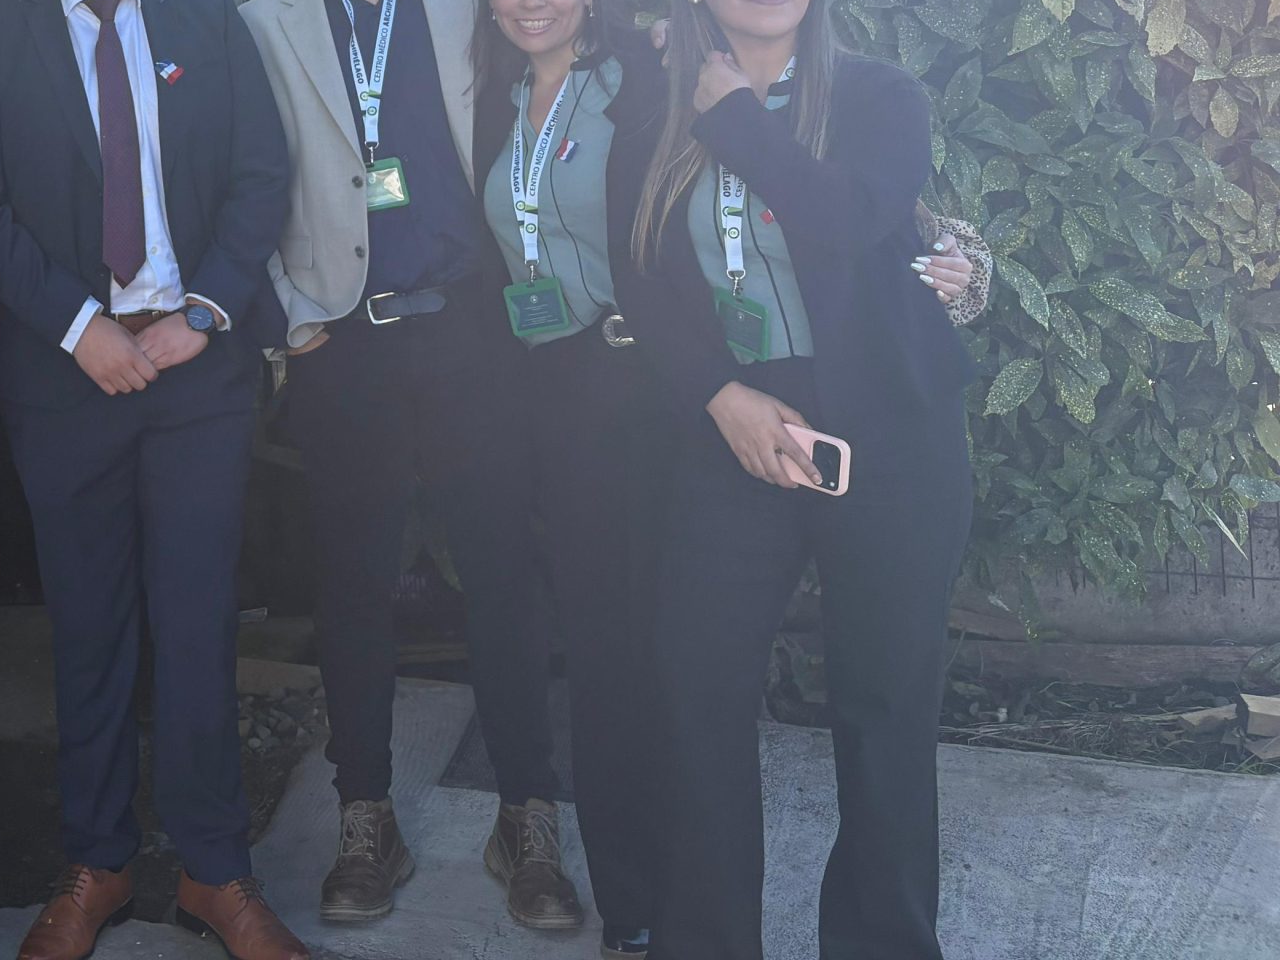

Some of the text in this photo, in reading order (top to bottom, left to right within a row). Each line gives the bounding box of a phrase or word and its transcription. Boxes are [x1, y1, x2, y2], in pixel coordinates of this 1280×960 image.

[377, 27, 388, 56] MÉDICO
[373, 56, 384, 83] CENTRO
[530, 166, 540, 197] CENTRO
[535, 138, 548, 166] MÉDICO
